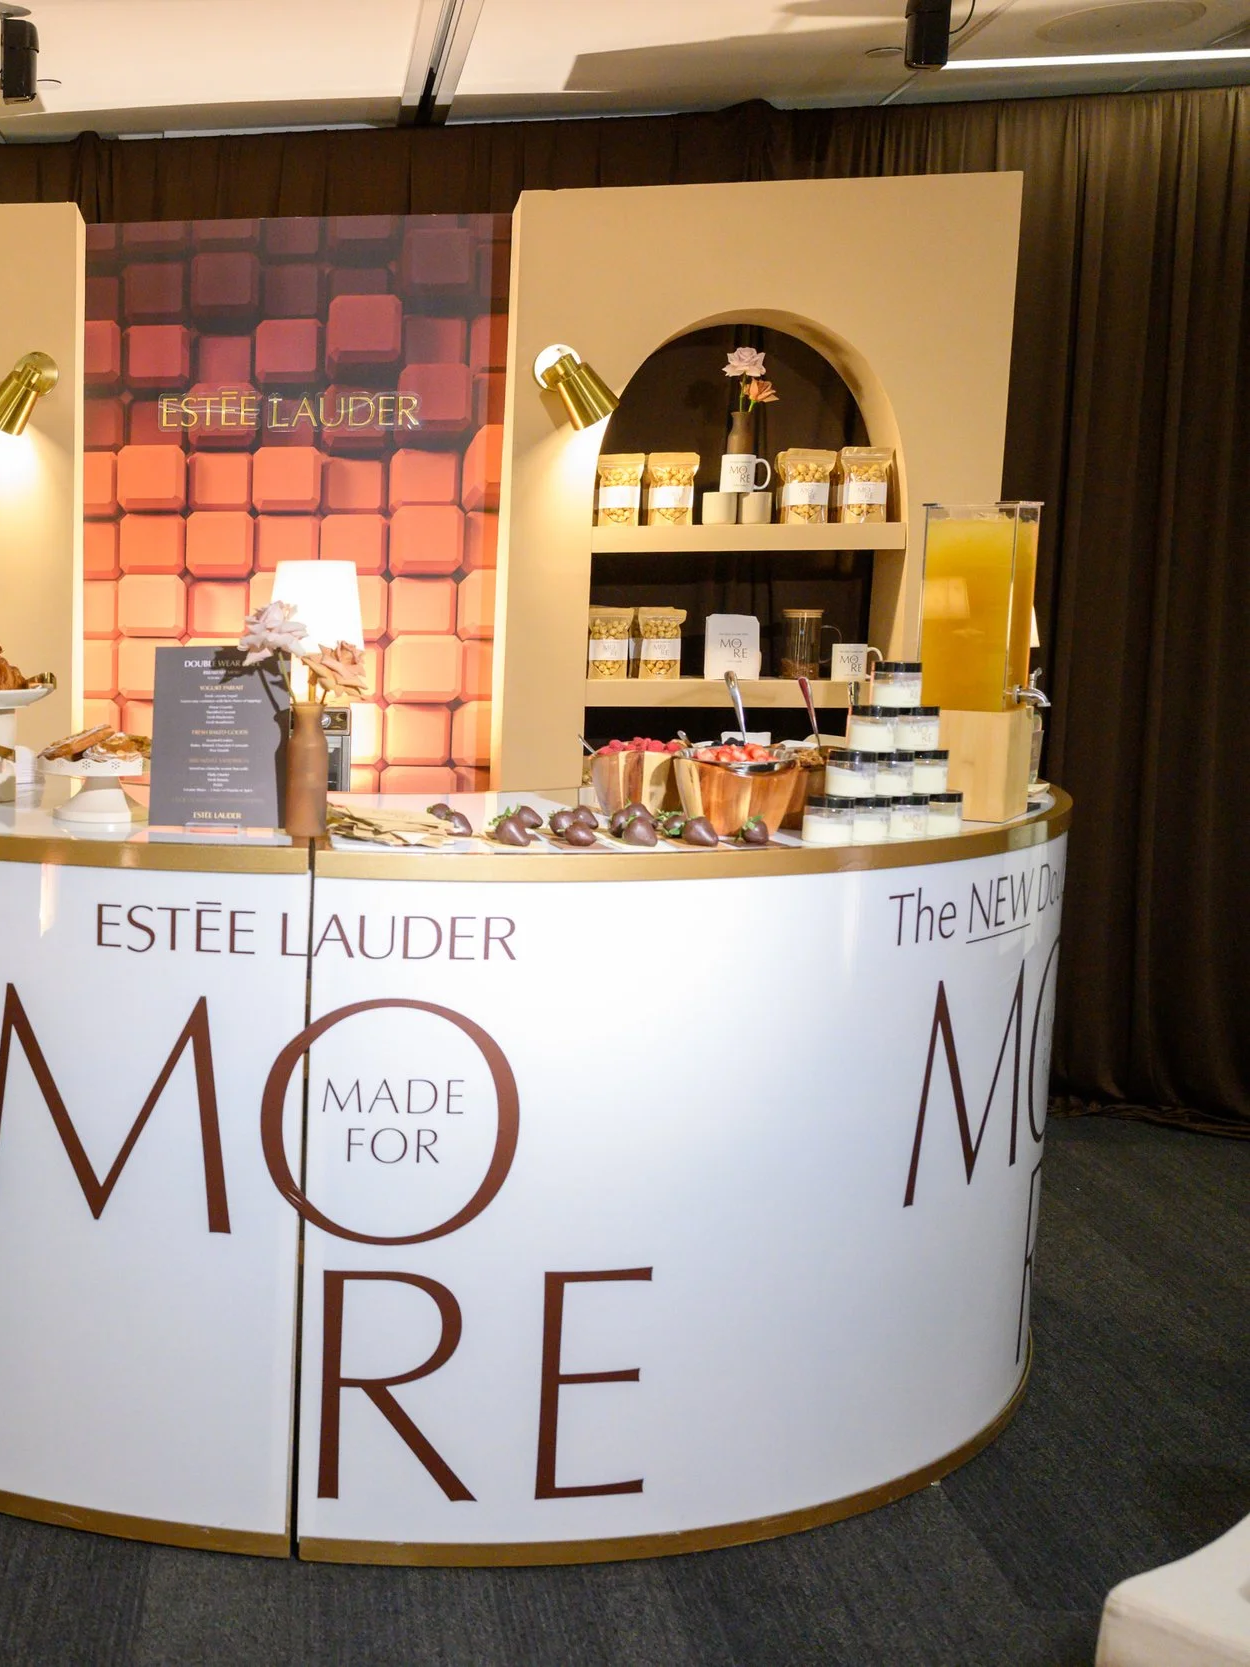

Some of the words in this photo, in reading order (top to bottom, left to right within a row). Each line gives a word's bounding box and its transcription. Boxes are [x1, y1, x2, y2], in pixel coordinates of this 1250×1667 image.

[270, 396, 420, 428] LAUDER
[720, 638, 742, 648] MO
[733, 648, 748, 658] RE
[184, 659, 216, 668] DOUBLE
[840, 655, 859, 664] MO
[851, 663, 862, 672] RE
[889, 887, 956, 946] The
[966, 868, 1034, 934] NEW
[281, 912, 517, 961] LAUDER
[321, 1079, 465, 1115] MADE
[346, 1128, 440, 1164] FOR
[317, 1266, 654, 1502] RE
